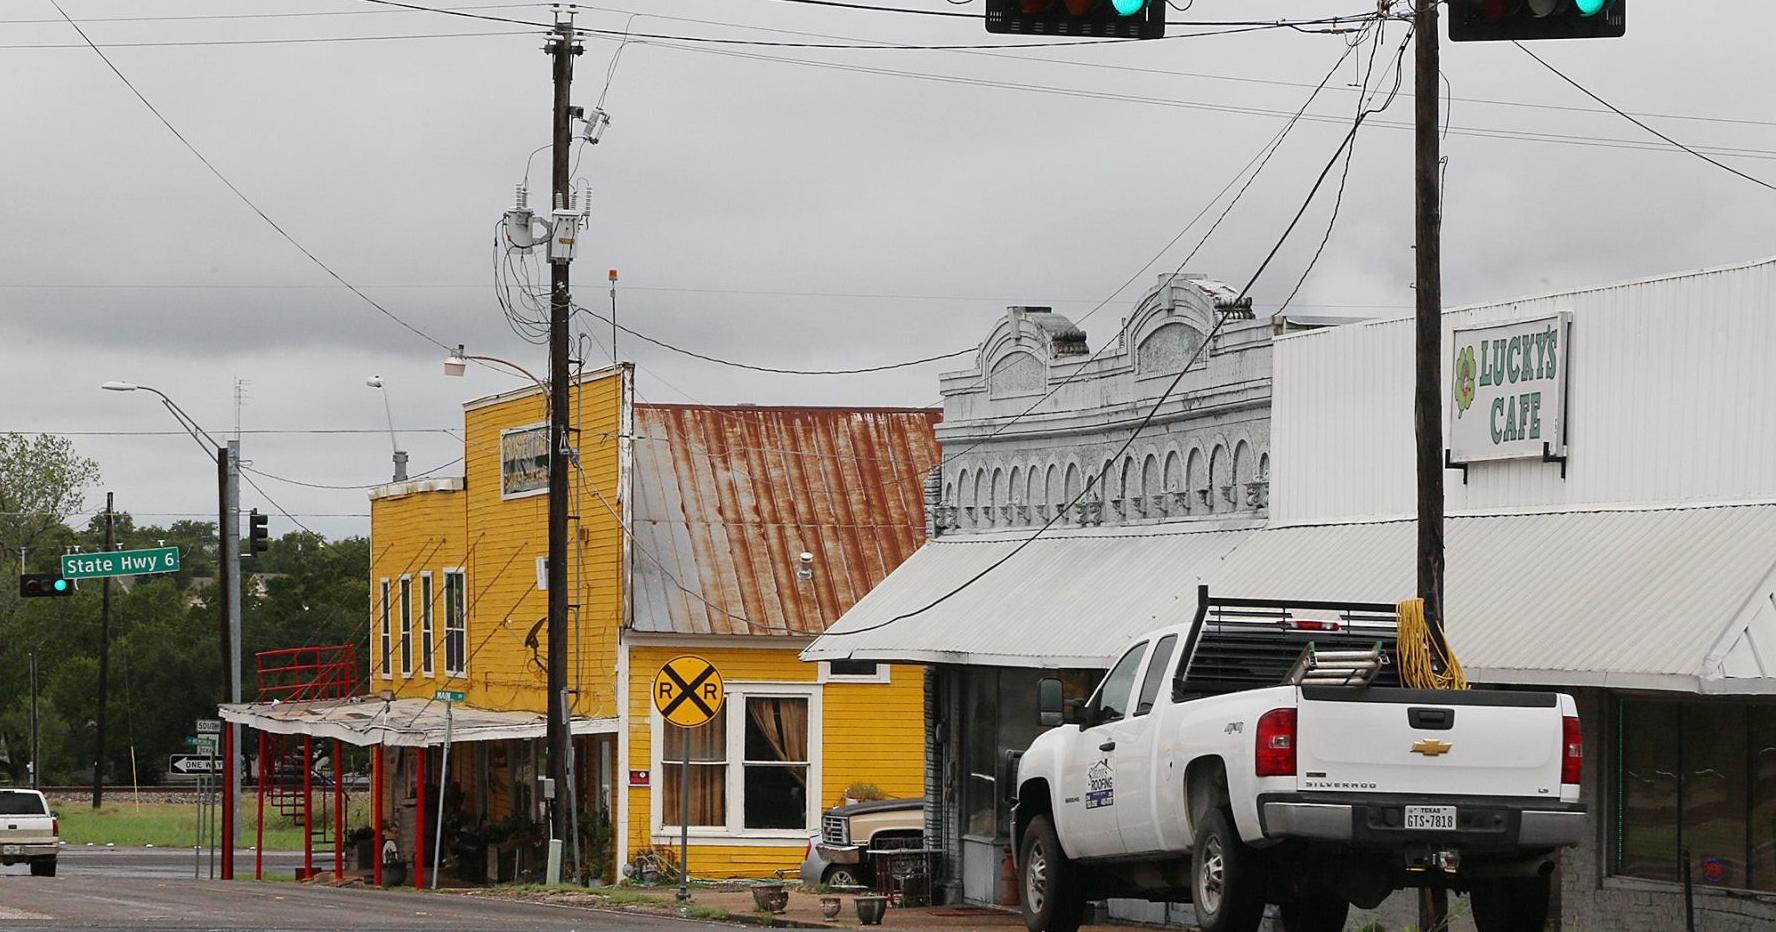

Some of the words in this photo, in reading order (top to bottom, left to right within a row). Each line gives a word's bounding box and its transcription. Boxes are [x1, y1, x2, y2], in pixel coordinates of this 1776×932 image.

[1479, 325, 1557, 386] LUCKY'S
[1490, 392, 1541, 445] CAFE
[67, 560, 113, 574] State
[121, 556, 157, 571] Hwy
[165, 552, 175, 567] 6
[659, 682, 673, 699] R
[704, 683, 718, 700] R
[185, 761, 203, 769] ONE
[1091, 776, 1113, 791] ROOFING
[1306, 781, 1377, 789] SILVERADO
[1408, 814, 1453, 828] GTS-7818
